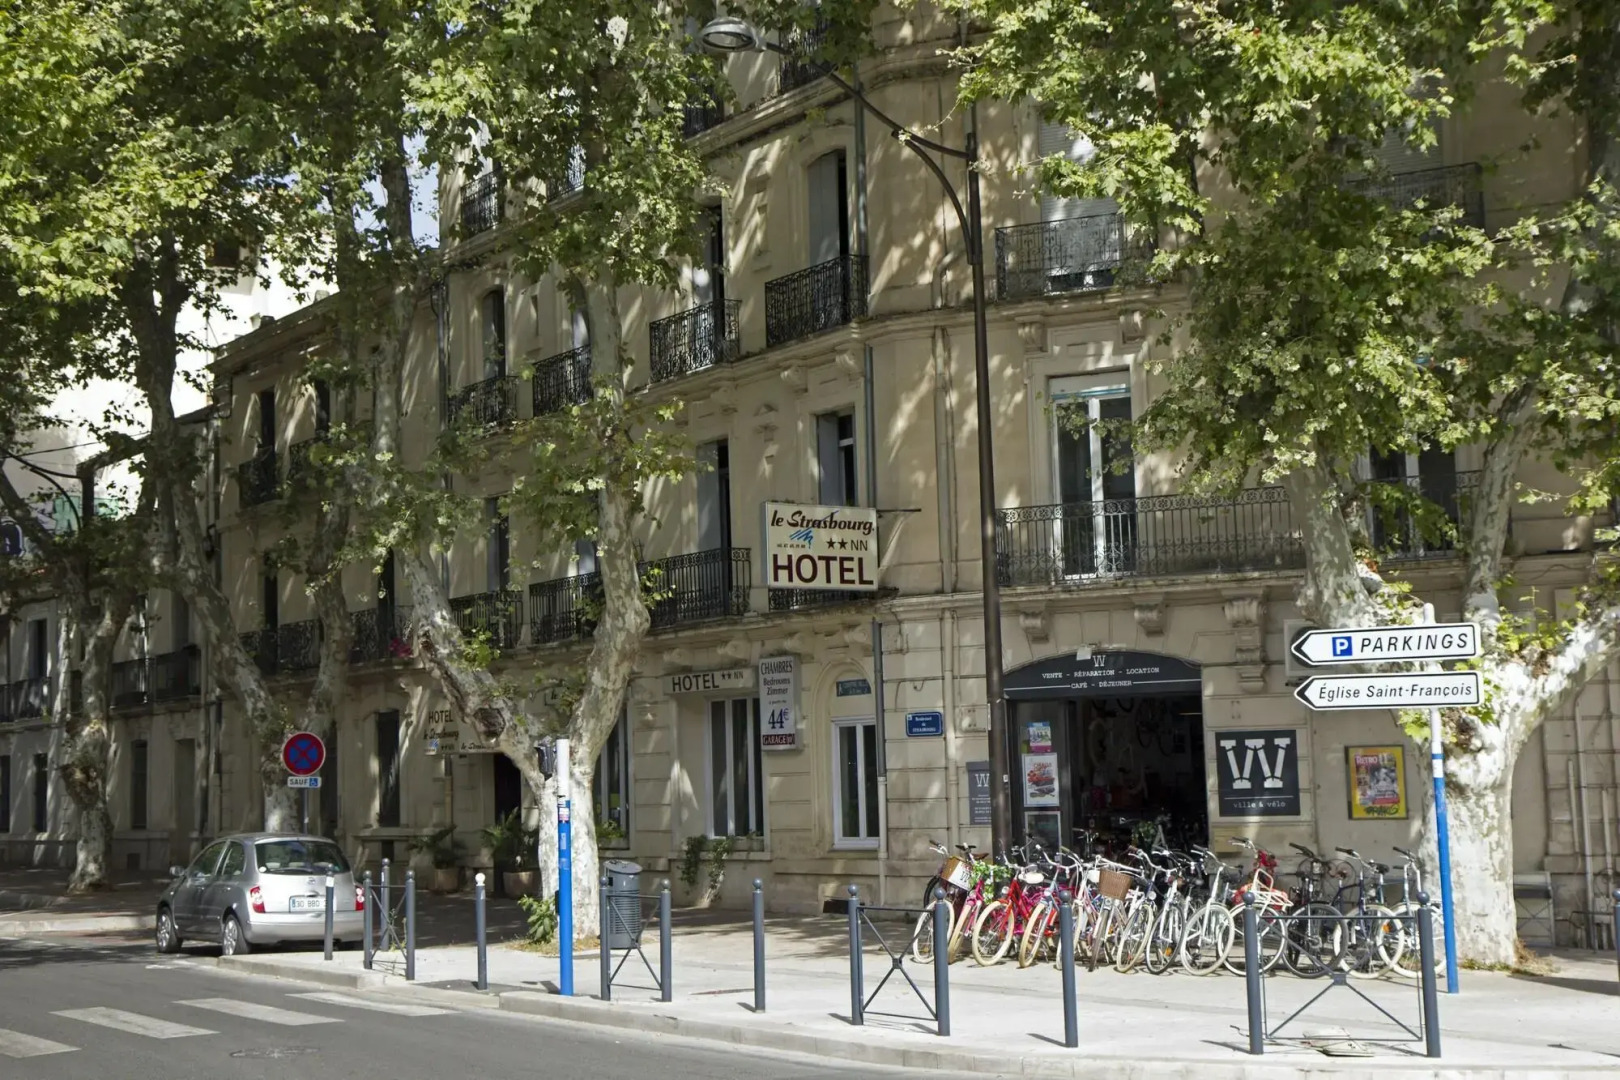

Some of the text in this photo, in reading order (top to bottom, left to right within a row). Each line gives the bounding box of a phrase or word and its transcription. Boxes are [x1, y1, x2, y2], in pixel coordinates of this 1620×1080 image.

[771, 510, 873, 536] le Strasbourg
[851, 540, 868, 551] NN
[773, 554, 874, 585] HOTEL
[1360, 633, 1468, 653] PARKINGS
[761, 660, 793, 675] CHAMBRES
[1092, 655, 1106, 667] W
[1074, 669, 1115, 678] RÉPARATION
[1126, 667, 1160, 675] LOCATION
[672, 673, 719, 692] HOTEL
[763, 677, 791, 686] Bedrooms
[1099, 680, 1132, 688] DÉJEUNER
[767, 687, 788, 695] Zimmer
[1319, 683, 1472, 702] Église Saint-François
[429, 710, 453, 724] HOTEL
[1220, 737, 1291, 789] W
[974, 773, 990, 787] W
[1233, 801, 1256, 809] ville
